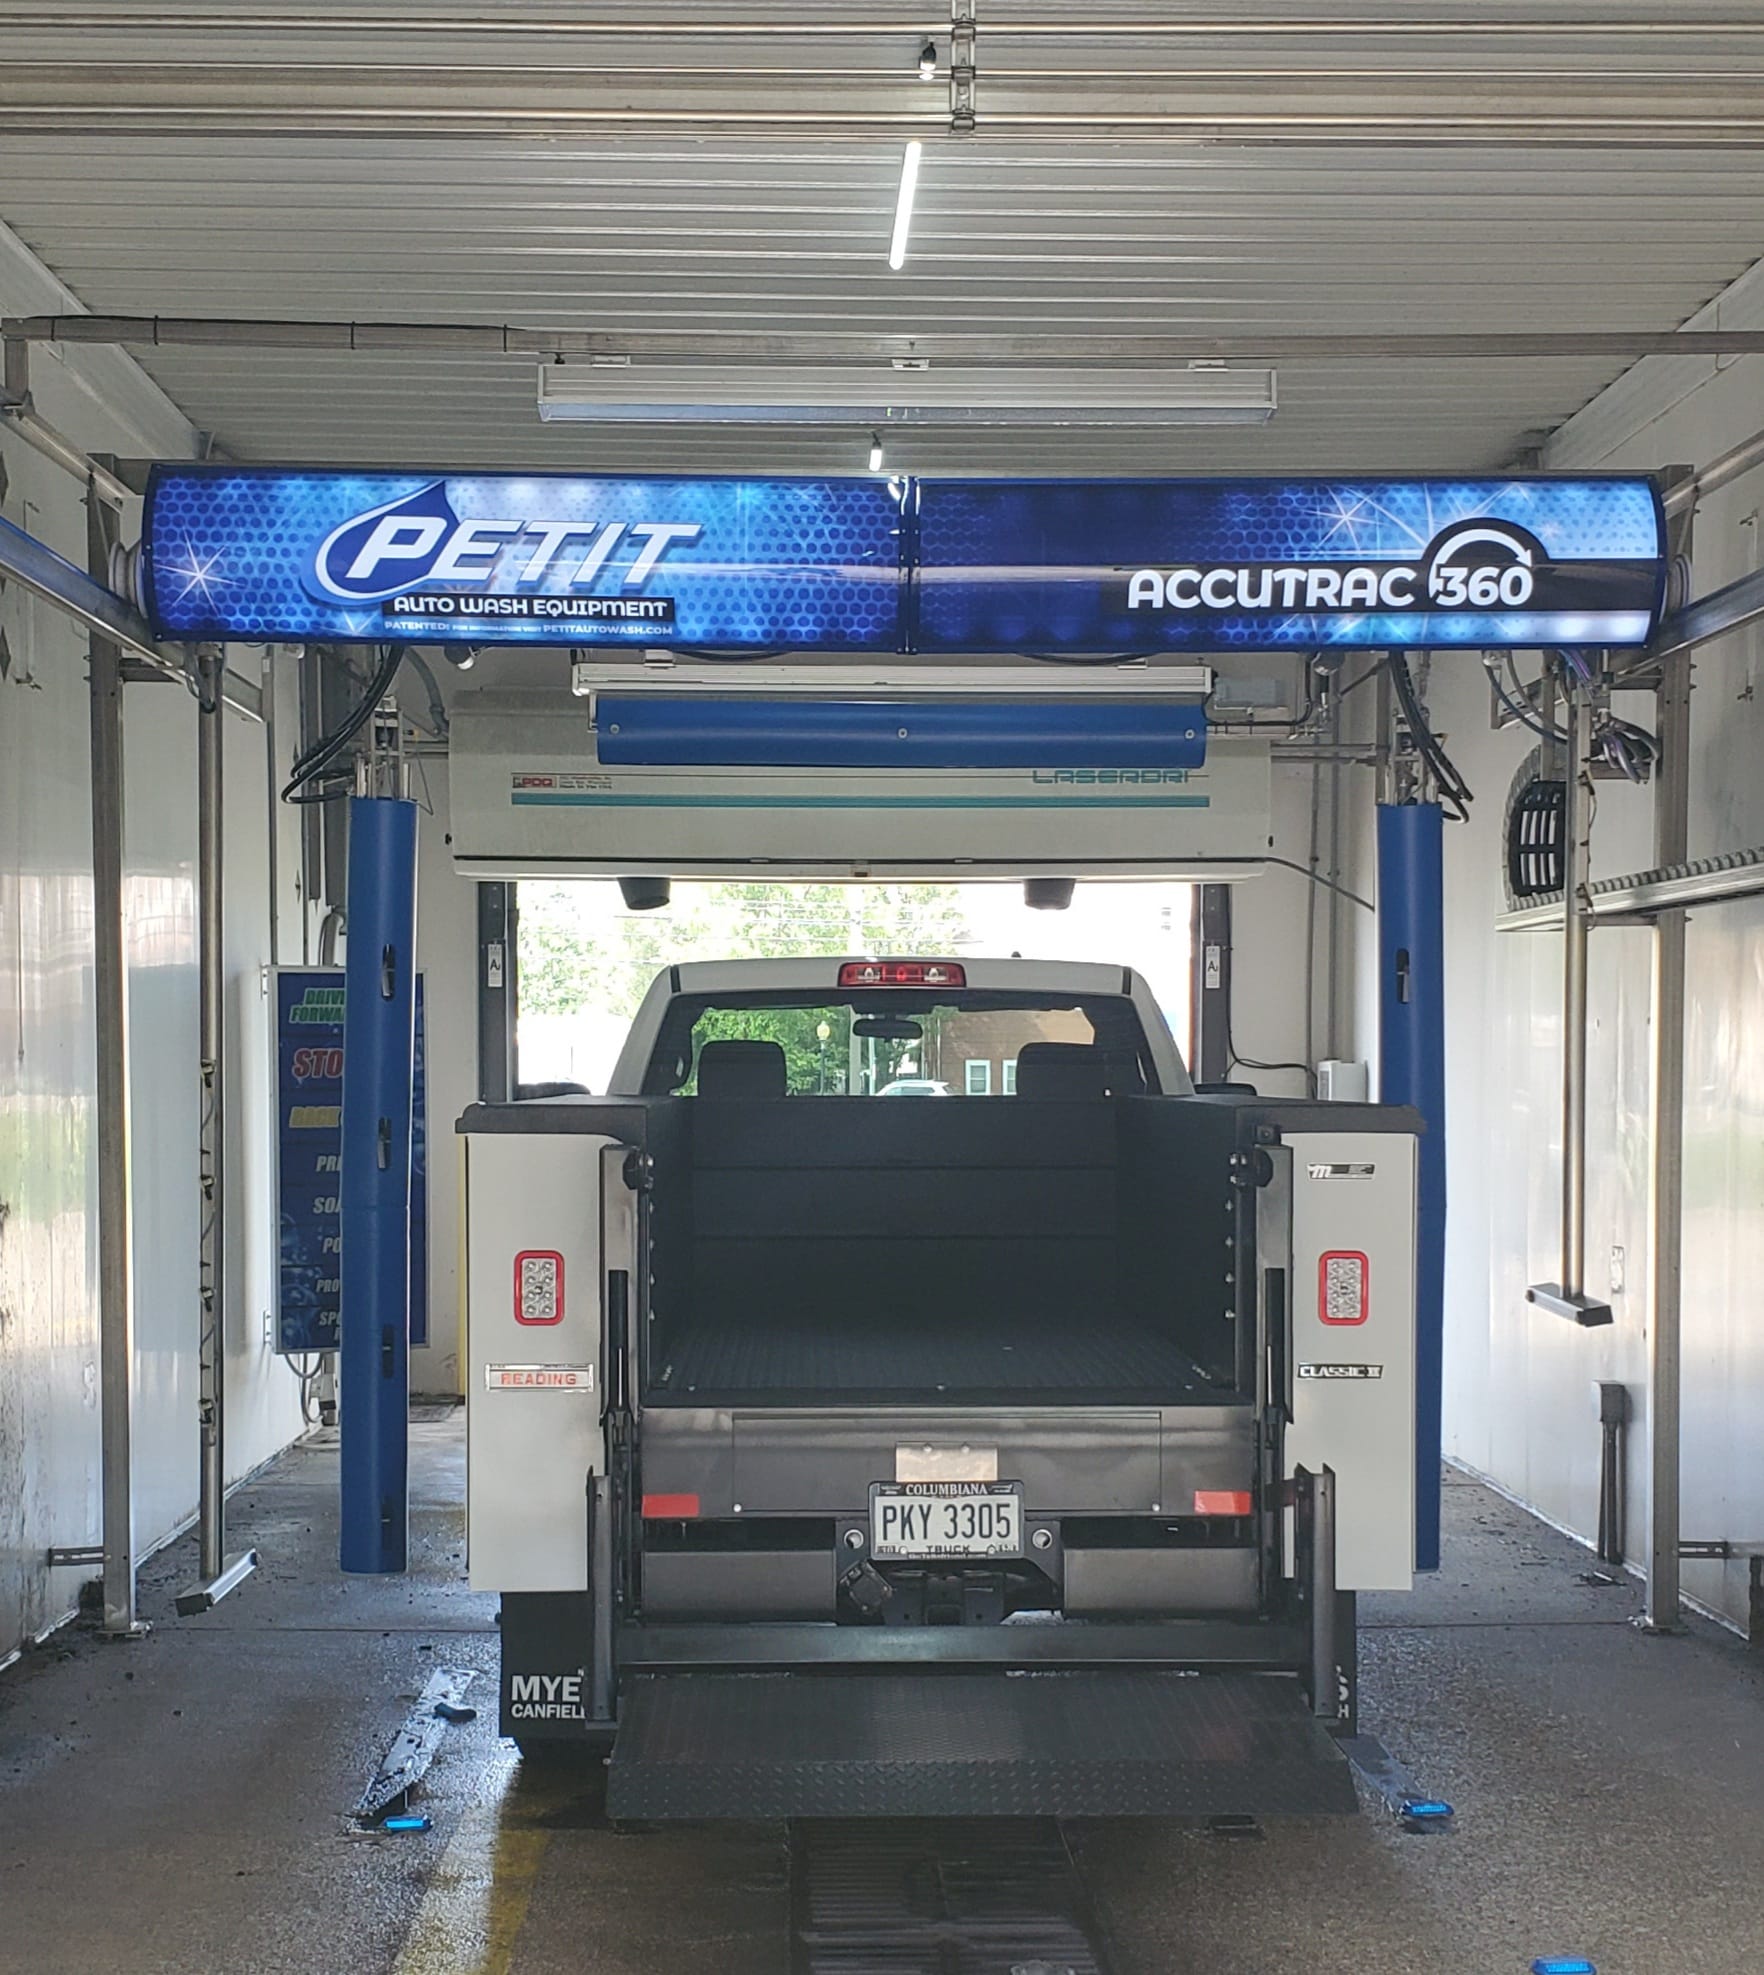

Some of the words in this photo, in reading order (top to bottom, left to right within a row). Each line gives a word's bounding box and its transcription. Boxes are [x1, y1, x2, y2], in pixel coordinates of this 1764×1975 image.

[345, 515, 702, 586] PETIT
[1128, 566, 1417, 609] ACCUTRAC
[1435, 566, 1534, 606] 360
[393, 596, 454, 613] AUTO
[459, 598, 528, 615] WASH
[533, 599, 668, 617] EQUIPMENT
[543, 624, 673, 635] PETITAUTOWASH.COM
[304, 988, 346, 1006] DRIV
[289, 1005, 345, 1024] FORWA
[292, 1048, 344, 1078] STO
[501, 1372, 577, 1385] READING
[1299, 1365, 1366, 1378] CLASSIC
[905, 1482, 988, 1496] COLUMBIANA
[882, 1503, 932, 1541] PKY
[943, 1503, 1011, 1540] 3305
[926, 1544, 971, 1554] TRUCK
[511, 1674, 582, 1702] MYE
